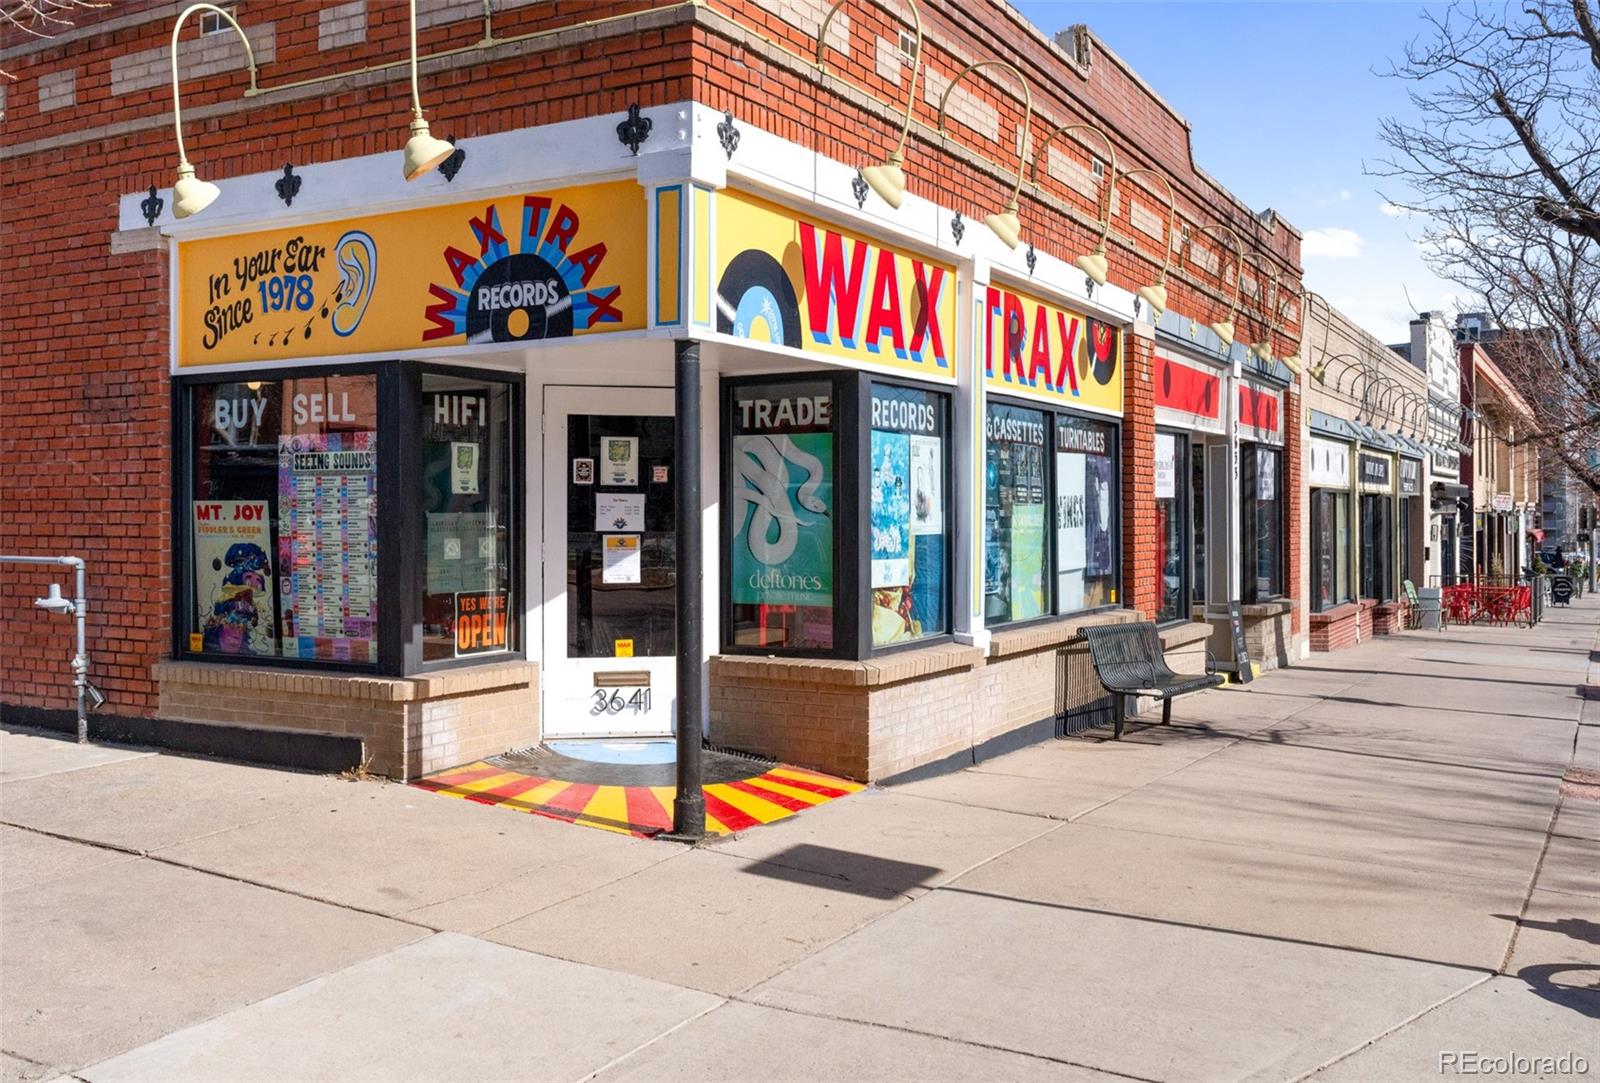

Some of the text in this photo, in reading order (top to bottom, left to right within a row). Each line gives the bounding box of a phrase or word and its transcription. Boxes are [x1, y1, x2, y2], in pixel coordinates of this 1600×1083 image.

[209, 273, 232, 305] In
[284, 236, 326, 273] Ear
[422, 196, 623, 342] WAX TRAX
[478, 280, 560, 310] RECORDS
[799, 221, 1080, 397] WAX TRAX
[203, 274, 314, 350] Since 1978
[214, 391, 356, 430] BUY SELL
[434, 394, 486, 427] HIFI
[738, 395, 832, 429] TRADE
[871, 397, 935, 431] RECORDS
[1059, 426, 1105, 453] TURNTABLES
[294, 452, 371, 470] SEEING SOUNDS
[196, 504, 264, 521] MT. JOY
[749, 568, 822, 590] deftones
[460, 597, 477, 611] YES
[458, 612, 506, 650] OPEN
[592, 688, 651, 713] 3641
